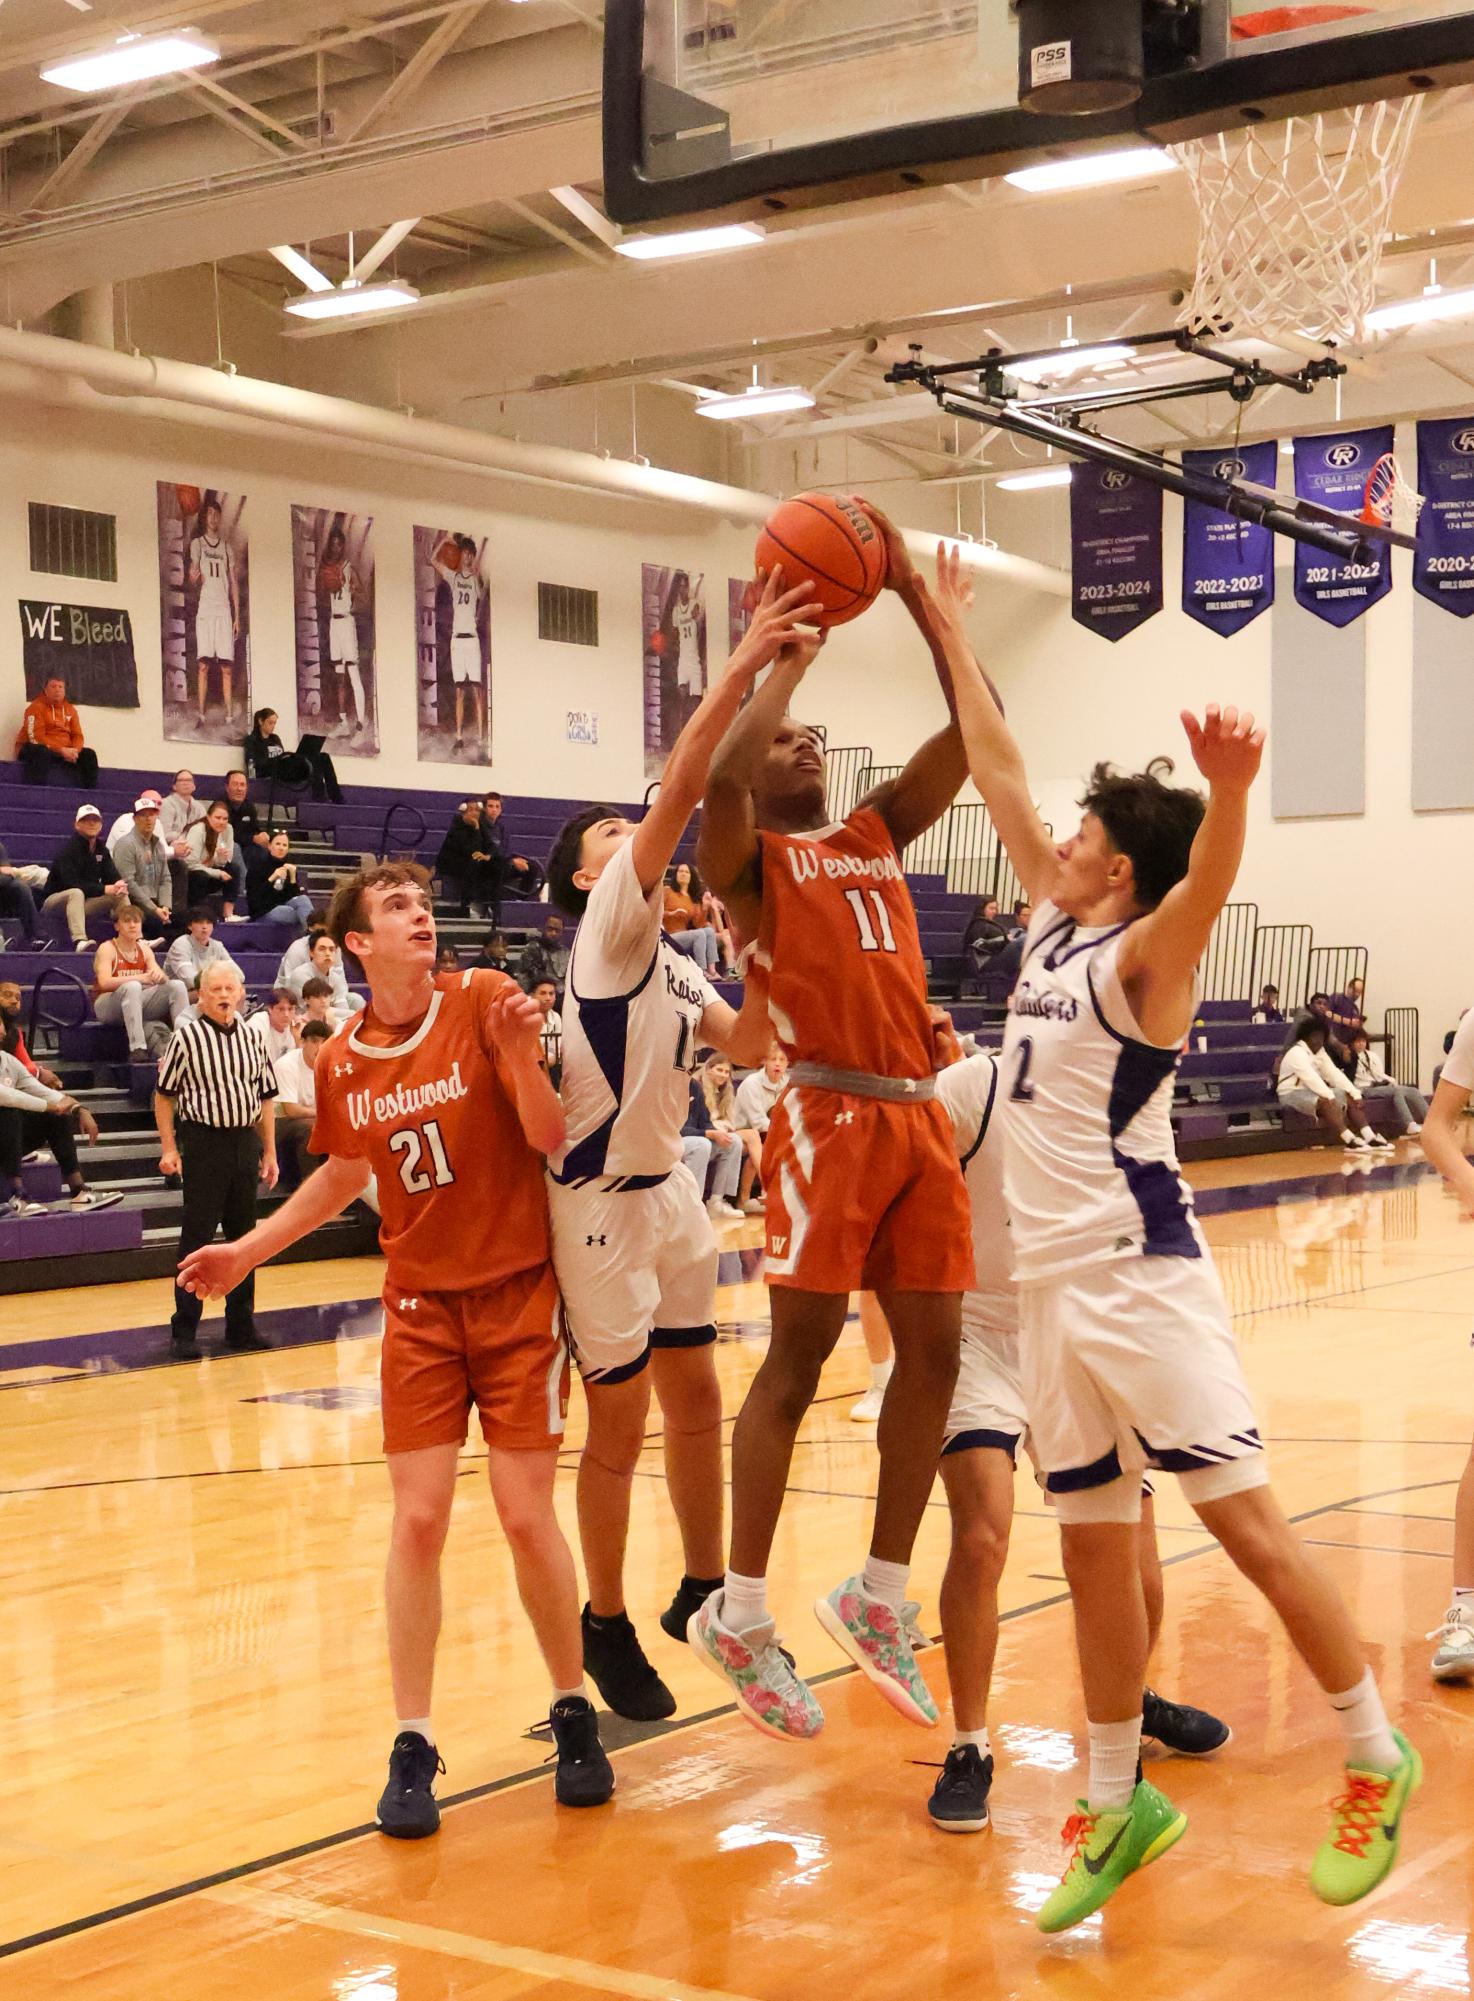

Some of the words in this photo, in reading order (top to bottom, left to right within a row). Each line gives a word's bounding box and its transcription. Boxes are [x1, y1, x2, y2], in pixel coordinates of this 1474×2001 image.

[1037, 47, 1066, 63] PSS
[210, 561, 219, 577] 11
[1306, 562, 1380, 583] 2021-2022
[1080, 580, 1150, 600] 2023-2024
[1194, 575, 1264, 594] 2022-2023
[24, 605, 63, 641] WE
[70, 608, 127, 645] Bleed
[644, 594, 661, 746] HAMILON
[843, 887, 898, 953] 11
[346, 1061, 468, 1131] Westwood
[388, 1119, 455, 1195] 21
[771, 1235, 787, 1255] W
